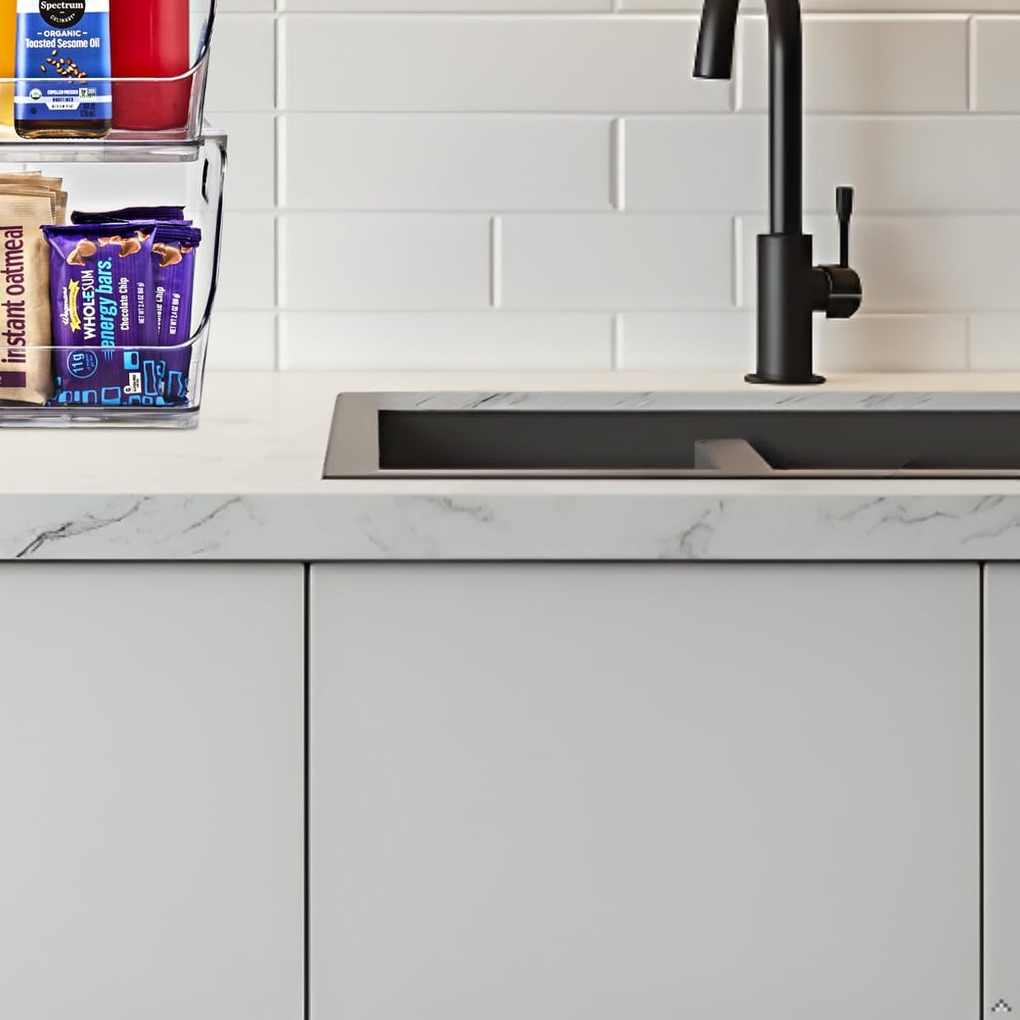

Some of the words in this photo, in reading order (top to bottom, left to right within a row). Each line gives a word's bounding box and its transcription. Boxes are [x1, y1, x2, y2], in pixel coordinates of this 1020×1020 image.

[40, 0, 84, 11] Spectrum
[25, 38, 56, 49] Toasted
[57, 38, 88, 49] Sesame
[89, 37, 101, 48] Oil
[0, 225, 25, 296] oatmeal
[95, 260, 113, 294] bars
[118, 277, 130, 294] Chip
[156, 286, 166, 302] Chip
[81, 270, 96, 340] WHOLESUM
[99, 296, 118, 347] energy
[119, 295, 130, 331] Chocolate
[1, 300, 26, 364] instant
[72, 353, 85, 374] 11g
